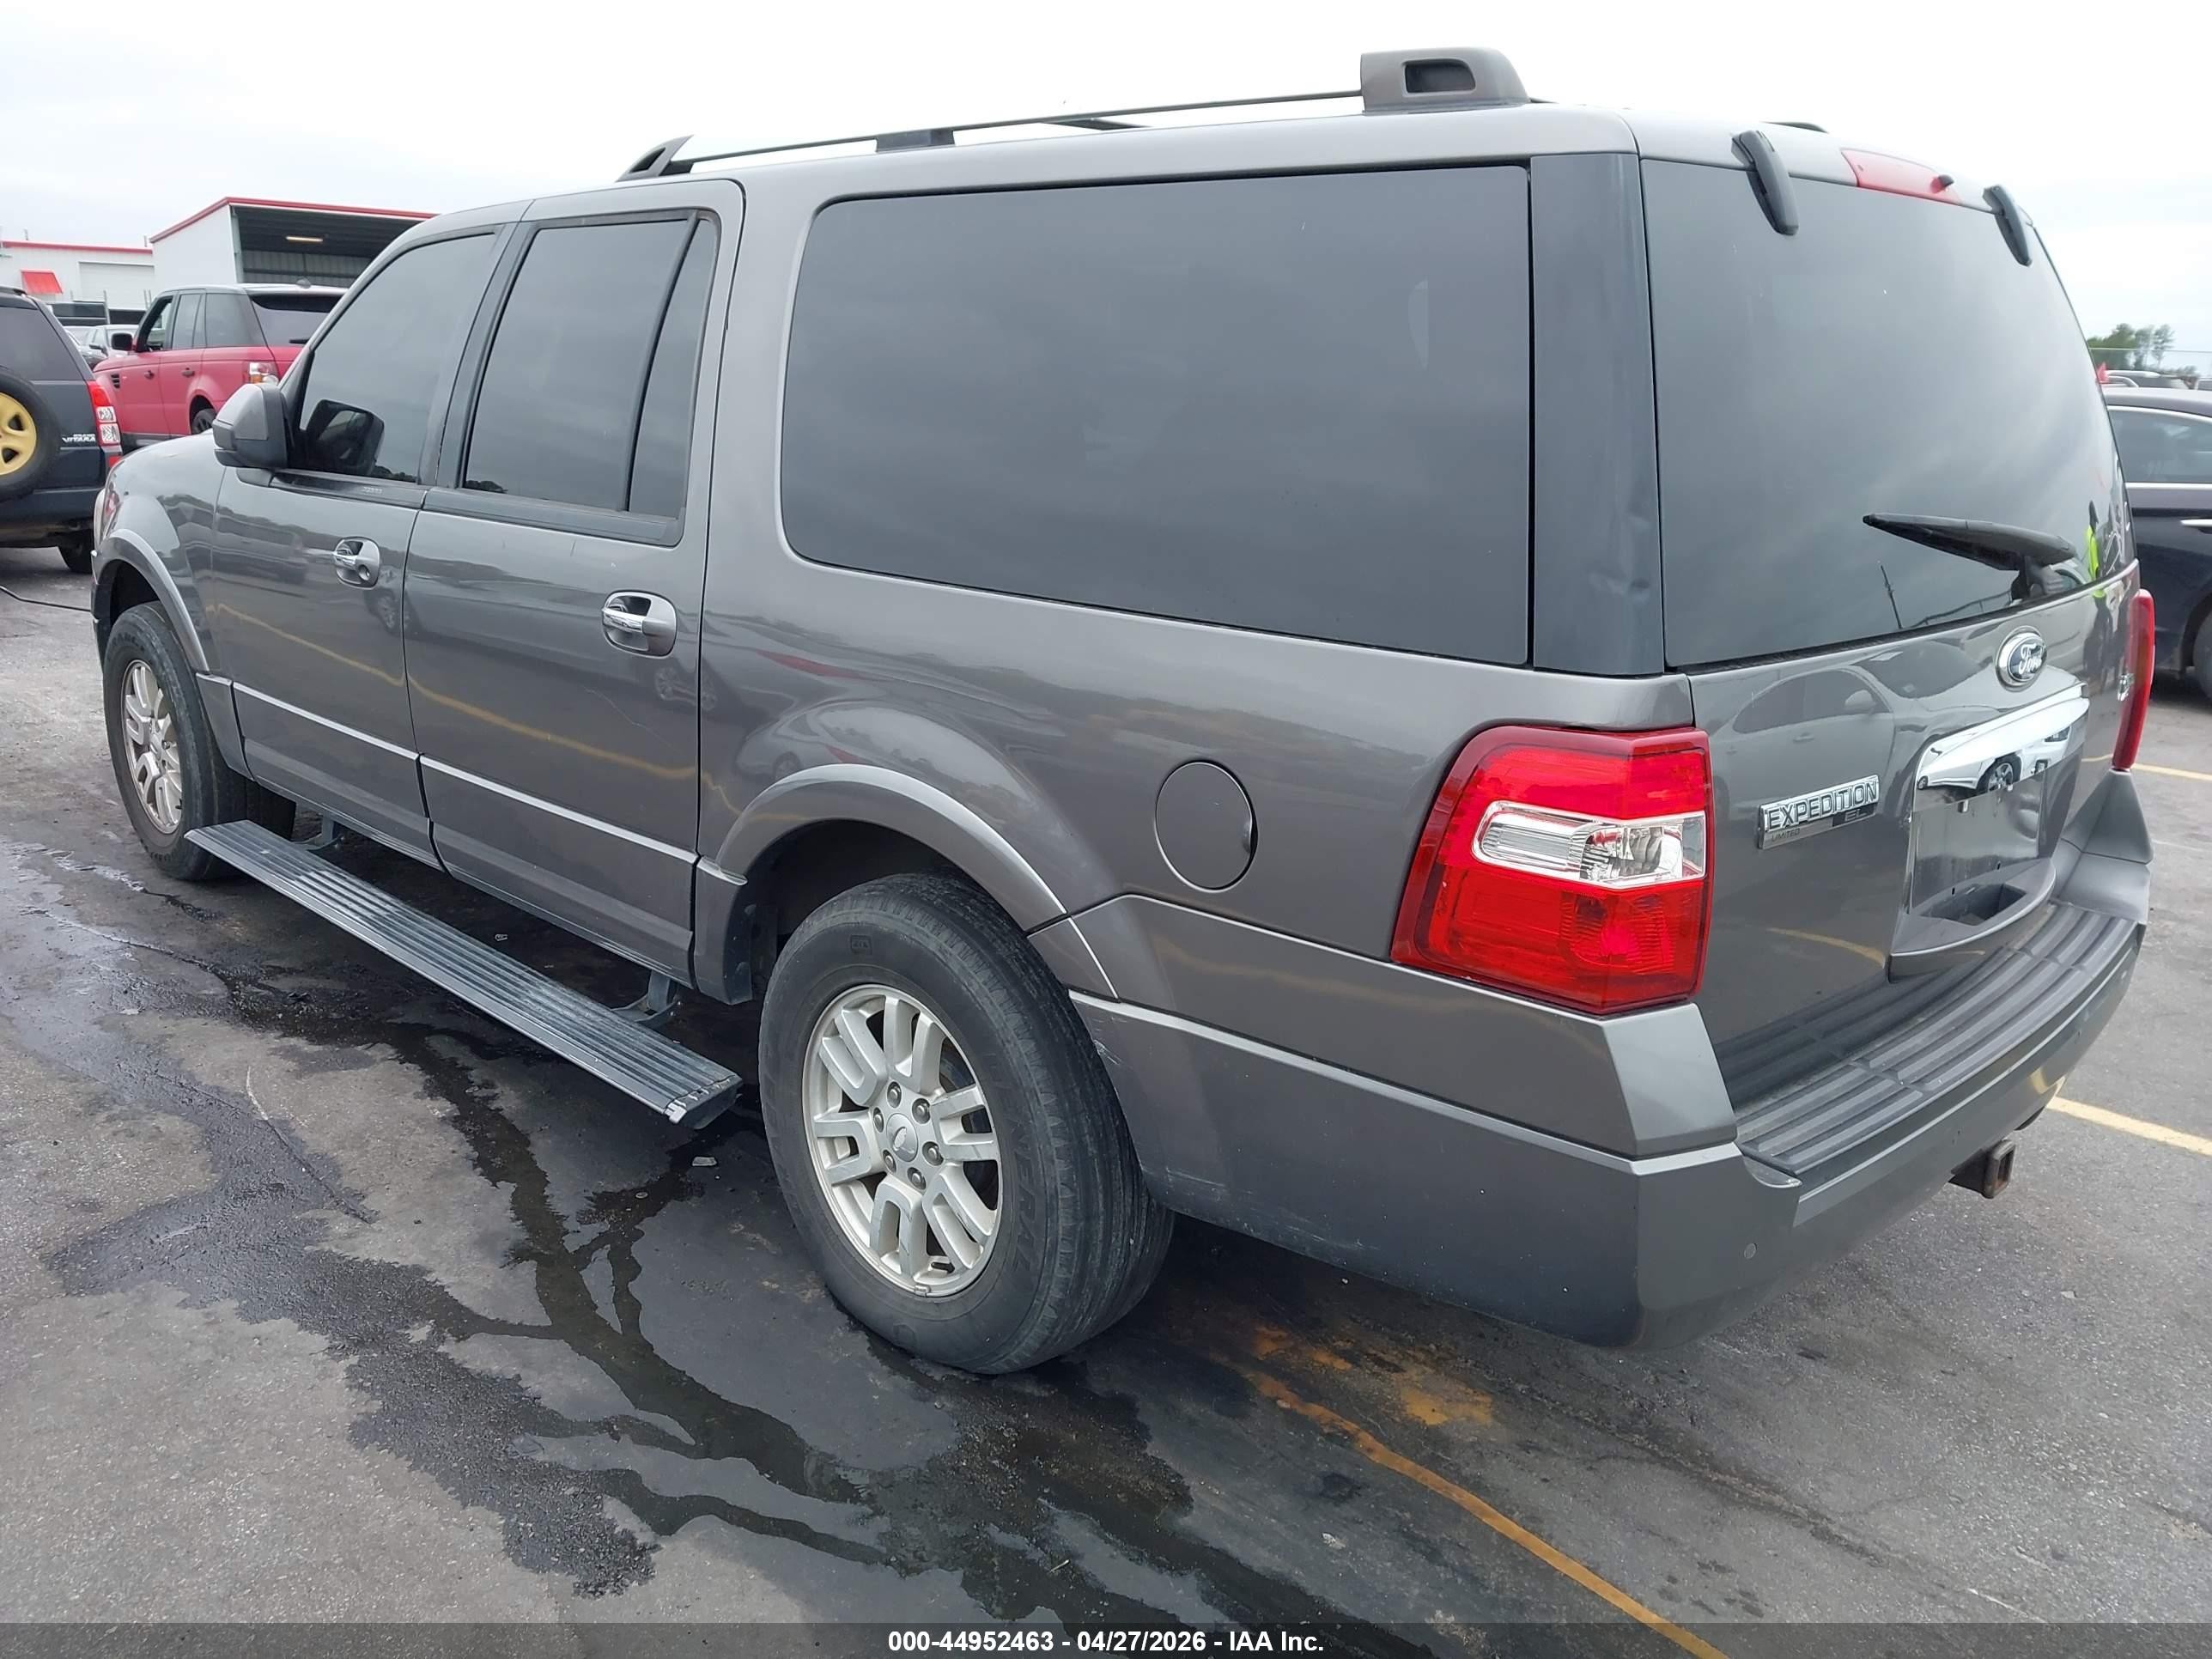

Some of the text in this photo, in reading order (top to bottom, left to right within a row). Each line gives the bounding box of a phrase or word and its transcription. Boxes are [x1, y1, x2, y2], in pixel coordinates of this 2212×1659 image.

[2019, 643, 2043, 674] Ford
[1768, 781, 1877, 830] EXPEDITION
[1844, 808, 1868, 822] EL
[1771, 828, 1801, 842] LIMITED
